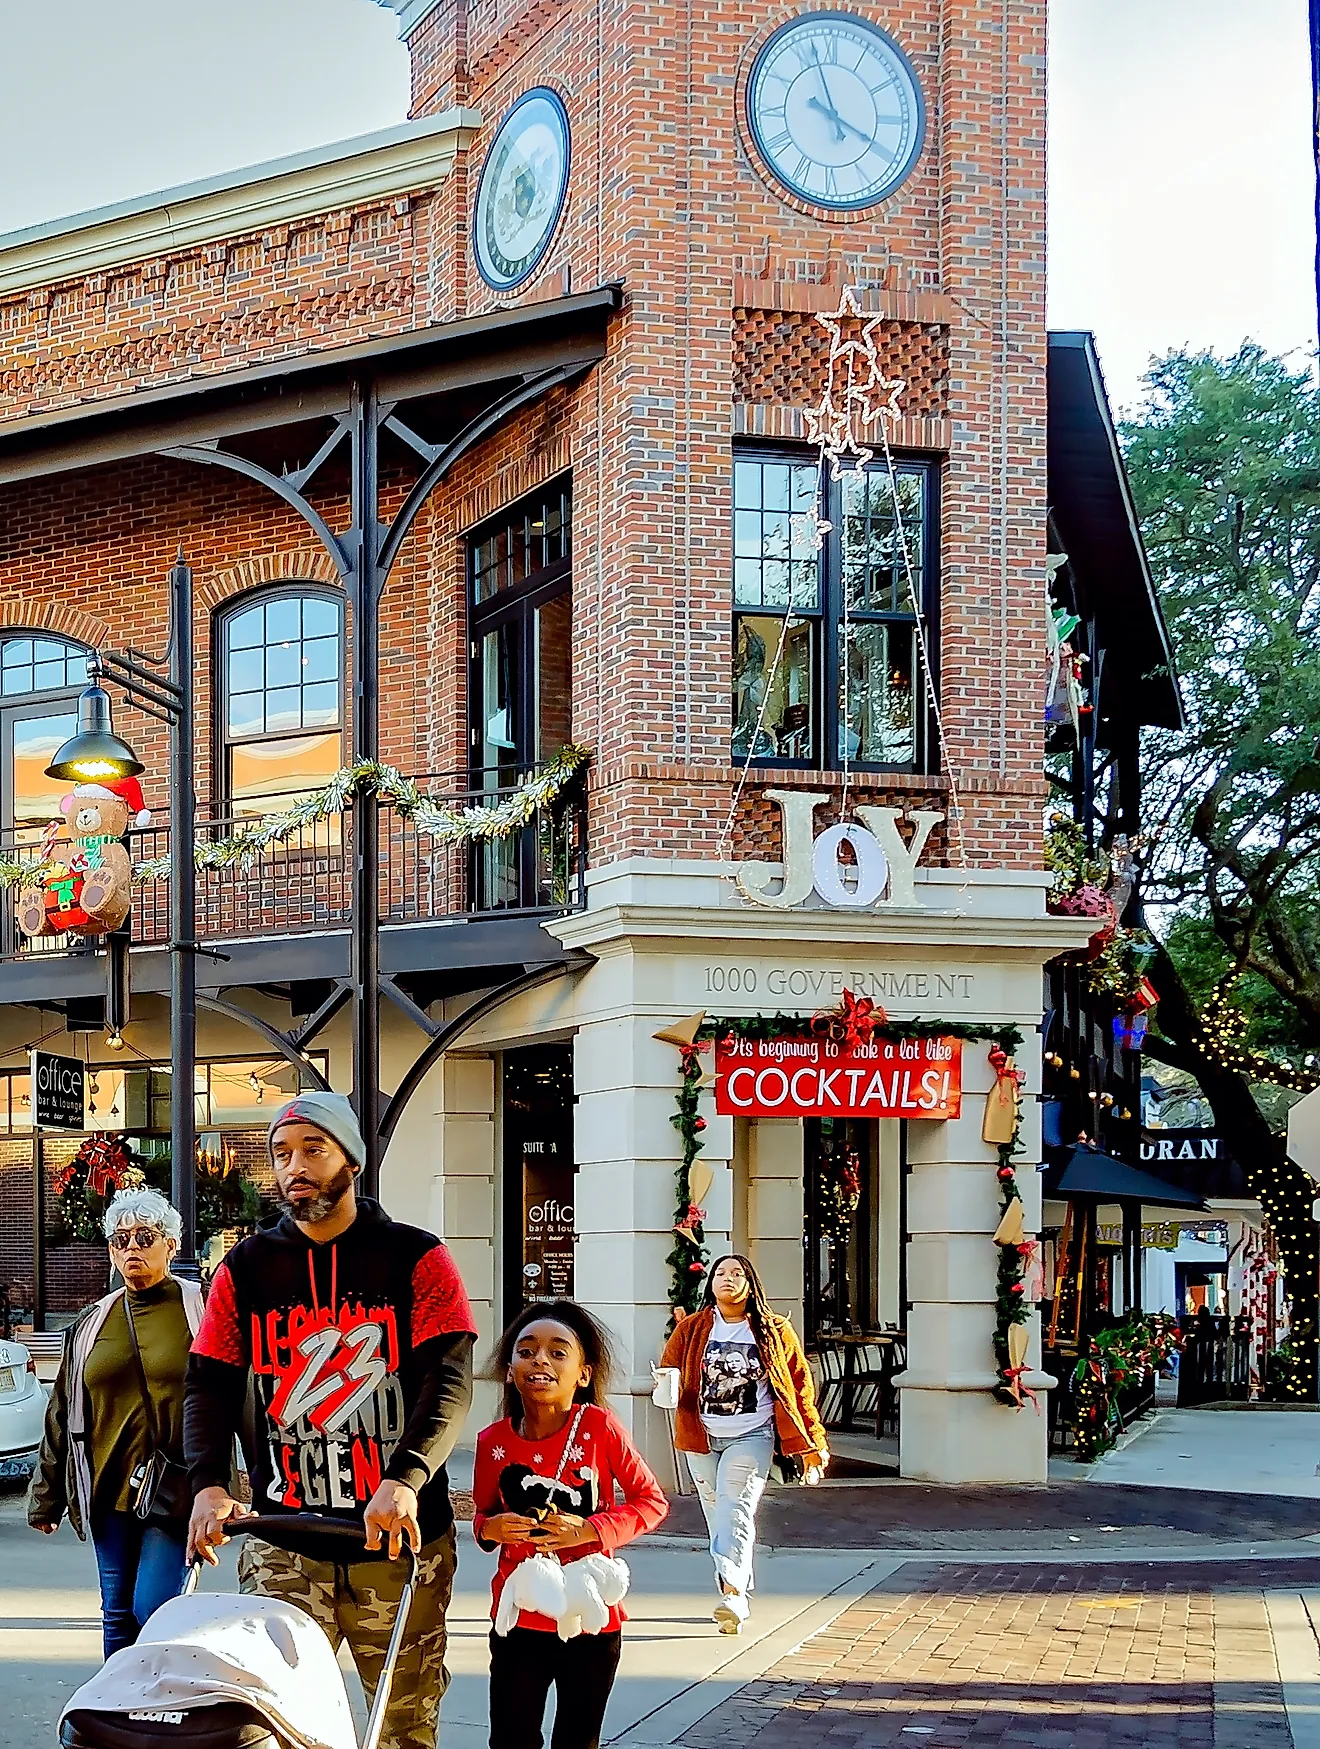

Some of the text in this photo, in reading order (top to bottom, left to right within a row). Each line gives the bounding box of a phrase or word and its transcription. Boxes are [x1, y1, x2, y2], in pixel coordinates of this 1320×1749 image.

[736, 789, 946, 908] JOY
[704, 967, 975, 998] 1000 GOVERNMENT
[759, 1039, 819, 1063] beginning
[825, 1039, 838, 1057] to
[852, 1038, 878, 1059] ook
[884, 1044, 894, 1059] a
[900, 1038, 920, 1060] lot
[926, 1038, 952, 1060] like
[38, 1058, 82, 1096] office
[727, 1067, 951, 1109] COCKTAILS!
[38, 1094, 82, 1113] bar & lounge
[523, 1142, 544, 1154] SUITE
[529, 1200, 574, 1222] offic
[529, 1224, 574, 1232] bar & lou
[268, 1322, 387, 1434] 23
